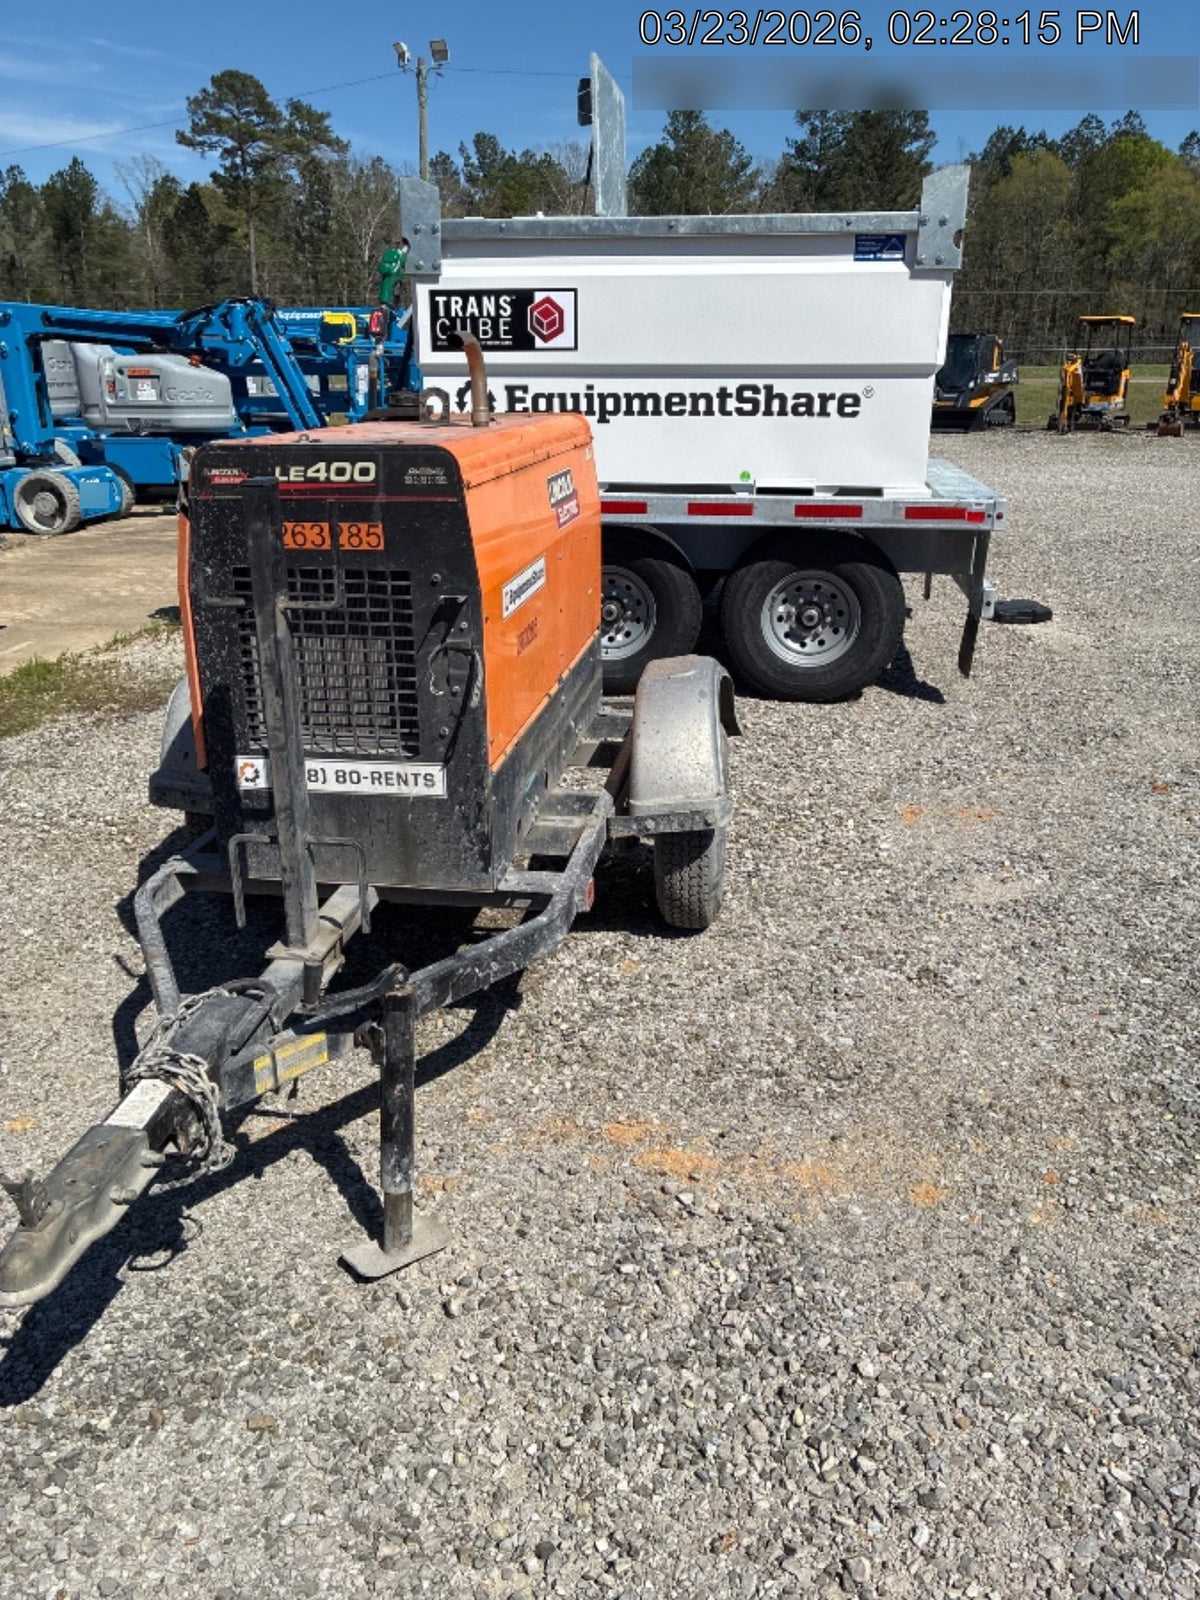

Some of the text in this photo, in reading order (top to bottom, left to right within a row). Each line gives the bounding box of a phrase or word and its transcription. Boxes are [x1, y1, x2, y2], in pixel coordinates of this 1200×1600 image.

[435, 295, 513, 317] TRANS
[274, 461, 377, 483] LE400
[335, 769, 436, 788] 80-RENTS
